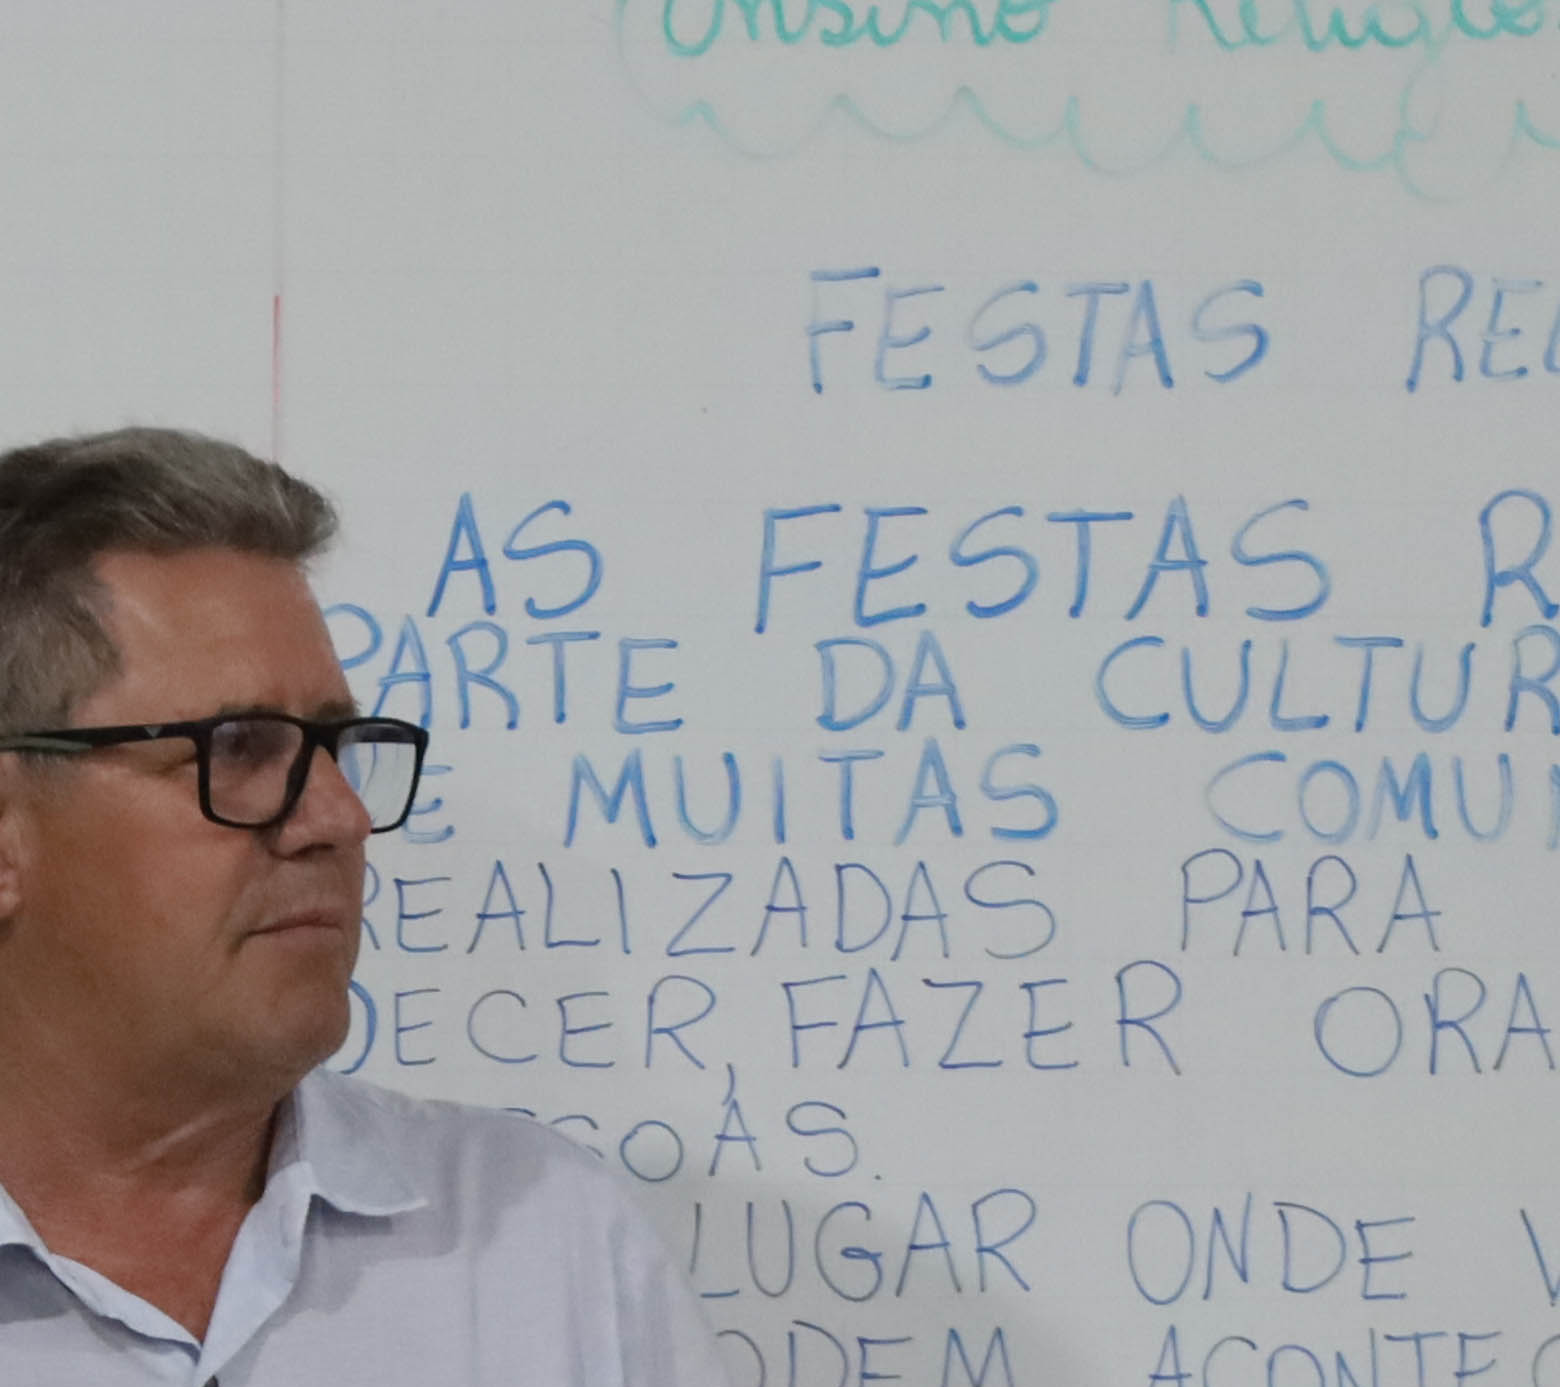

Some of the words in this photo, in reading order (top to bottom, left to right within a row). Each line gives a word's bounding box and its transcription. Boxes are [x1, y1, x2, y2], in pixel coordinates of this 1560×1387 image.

[806, 266, 1271, 395] FESTAS
[426, 493, 603, 621] AS
[754, 495, 1332, 635] FESTAS
[322, 603, 685, 733] PARTE
[813, 630, 966, 733] DA
[563, 737, 1059, 848] MUITAS
[1179, 847, 1443, 957] PARA
[781, 962, 1182, 1076] FAZER
[689, 1189, 1038, 1303] LUGAR
[1127, 1191, 1415, 1305] ONDE
